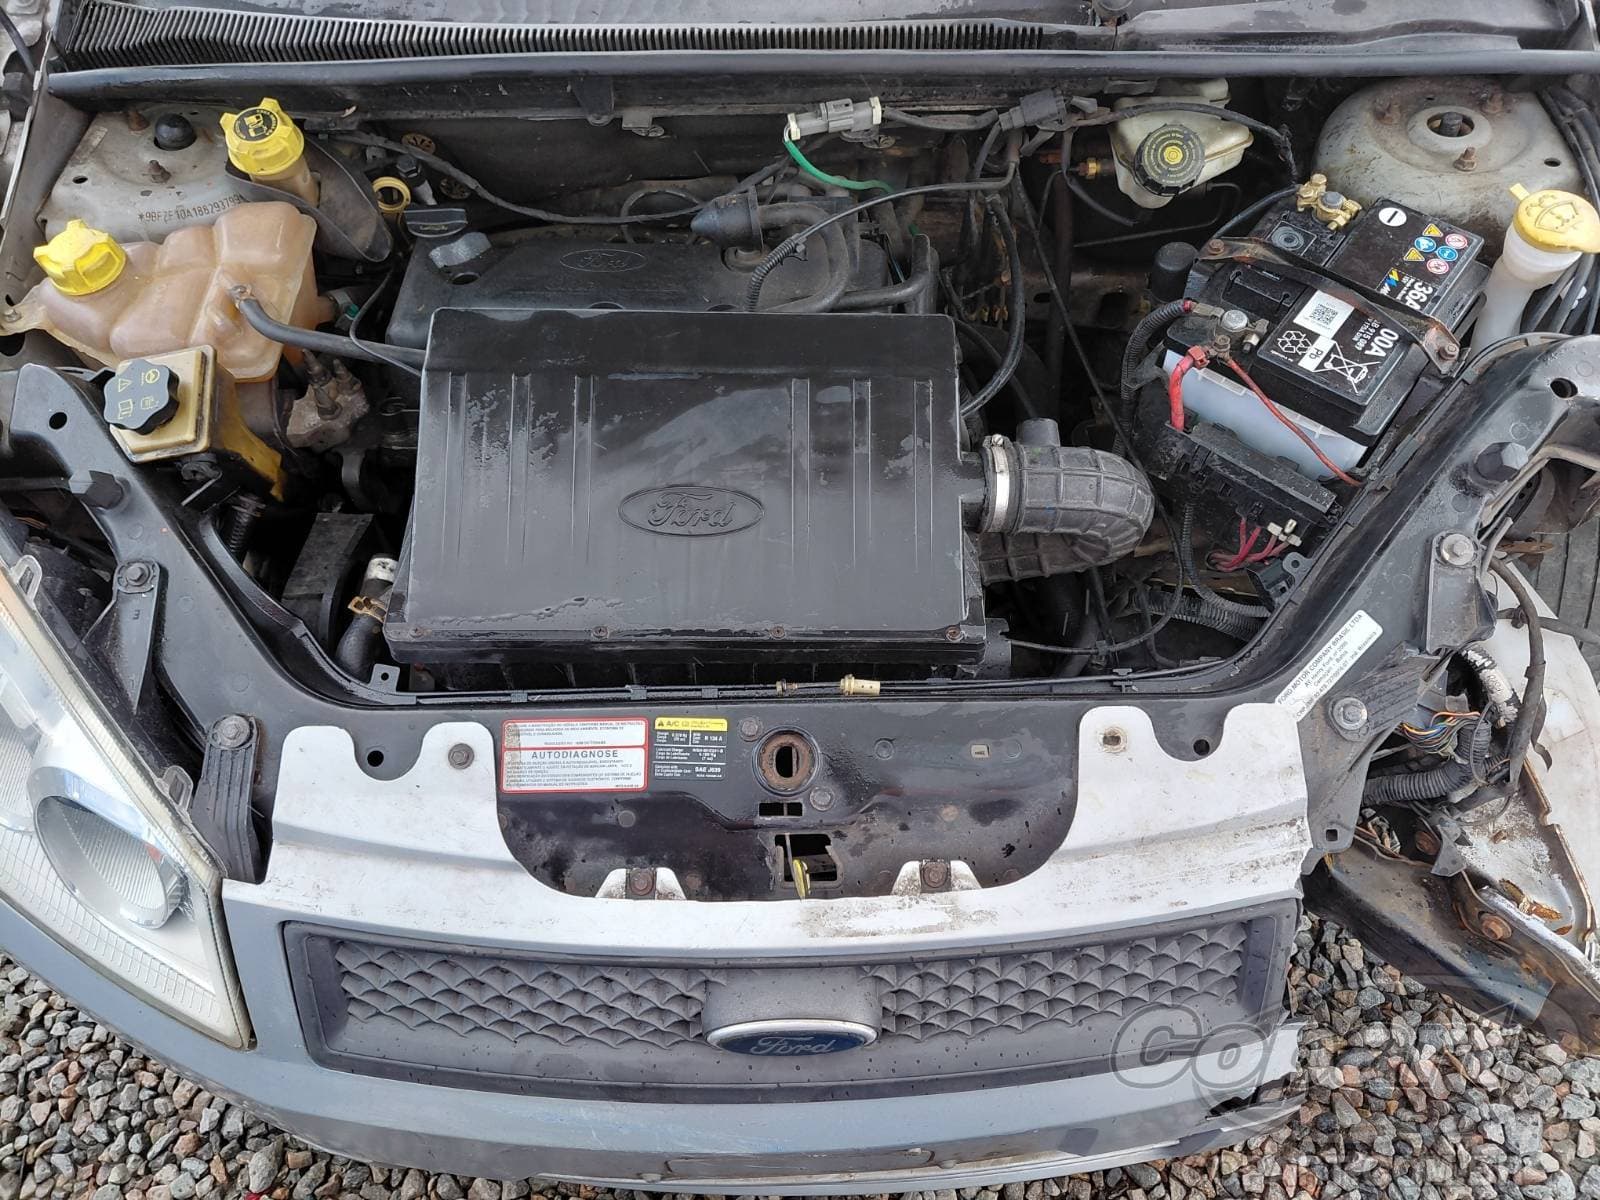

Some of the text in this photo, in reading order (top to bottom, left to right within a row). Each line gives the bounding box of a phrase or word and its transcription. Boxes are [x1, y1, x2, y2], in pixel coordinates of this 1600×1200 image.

[1309, 348, 1324, 360] Pb
[647, 491, 737, 527] Ford
[1292, 669, 1311, 689] MOTOR
[1310, 645, 1333, 671] COMPANY
[1333, 626, 1351, 647] BRASIL
[531, 750, 619, 760] AUTODIAGNOSE
[751, 1036, 836, 1055] Ford
